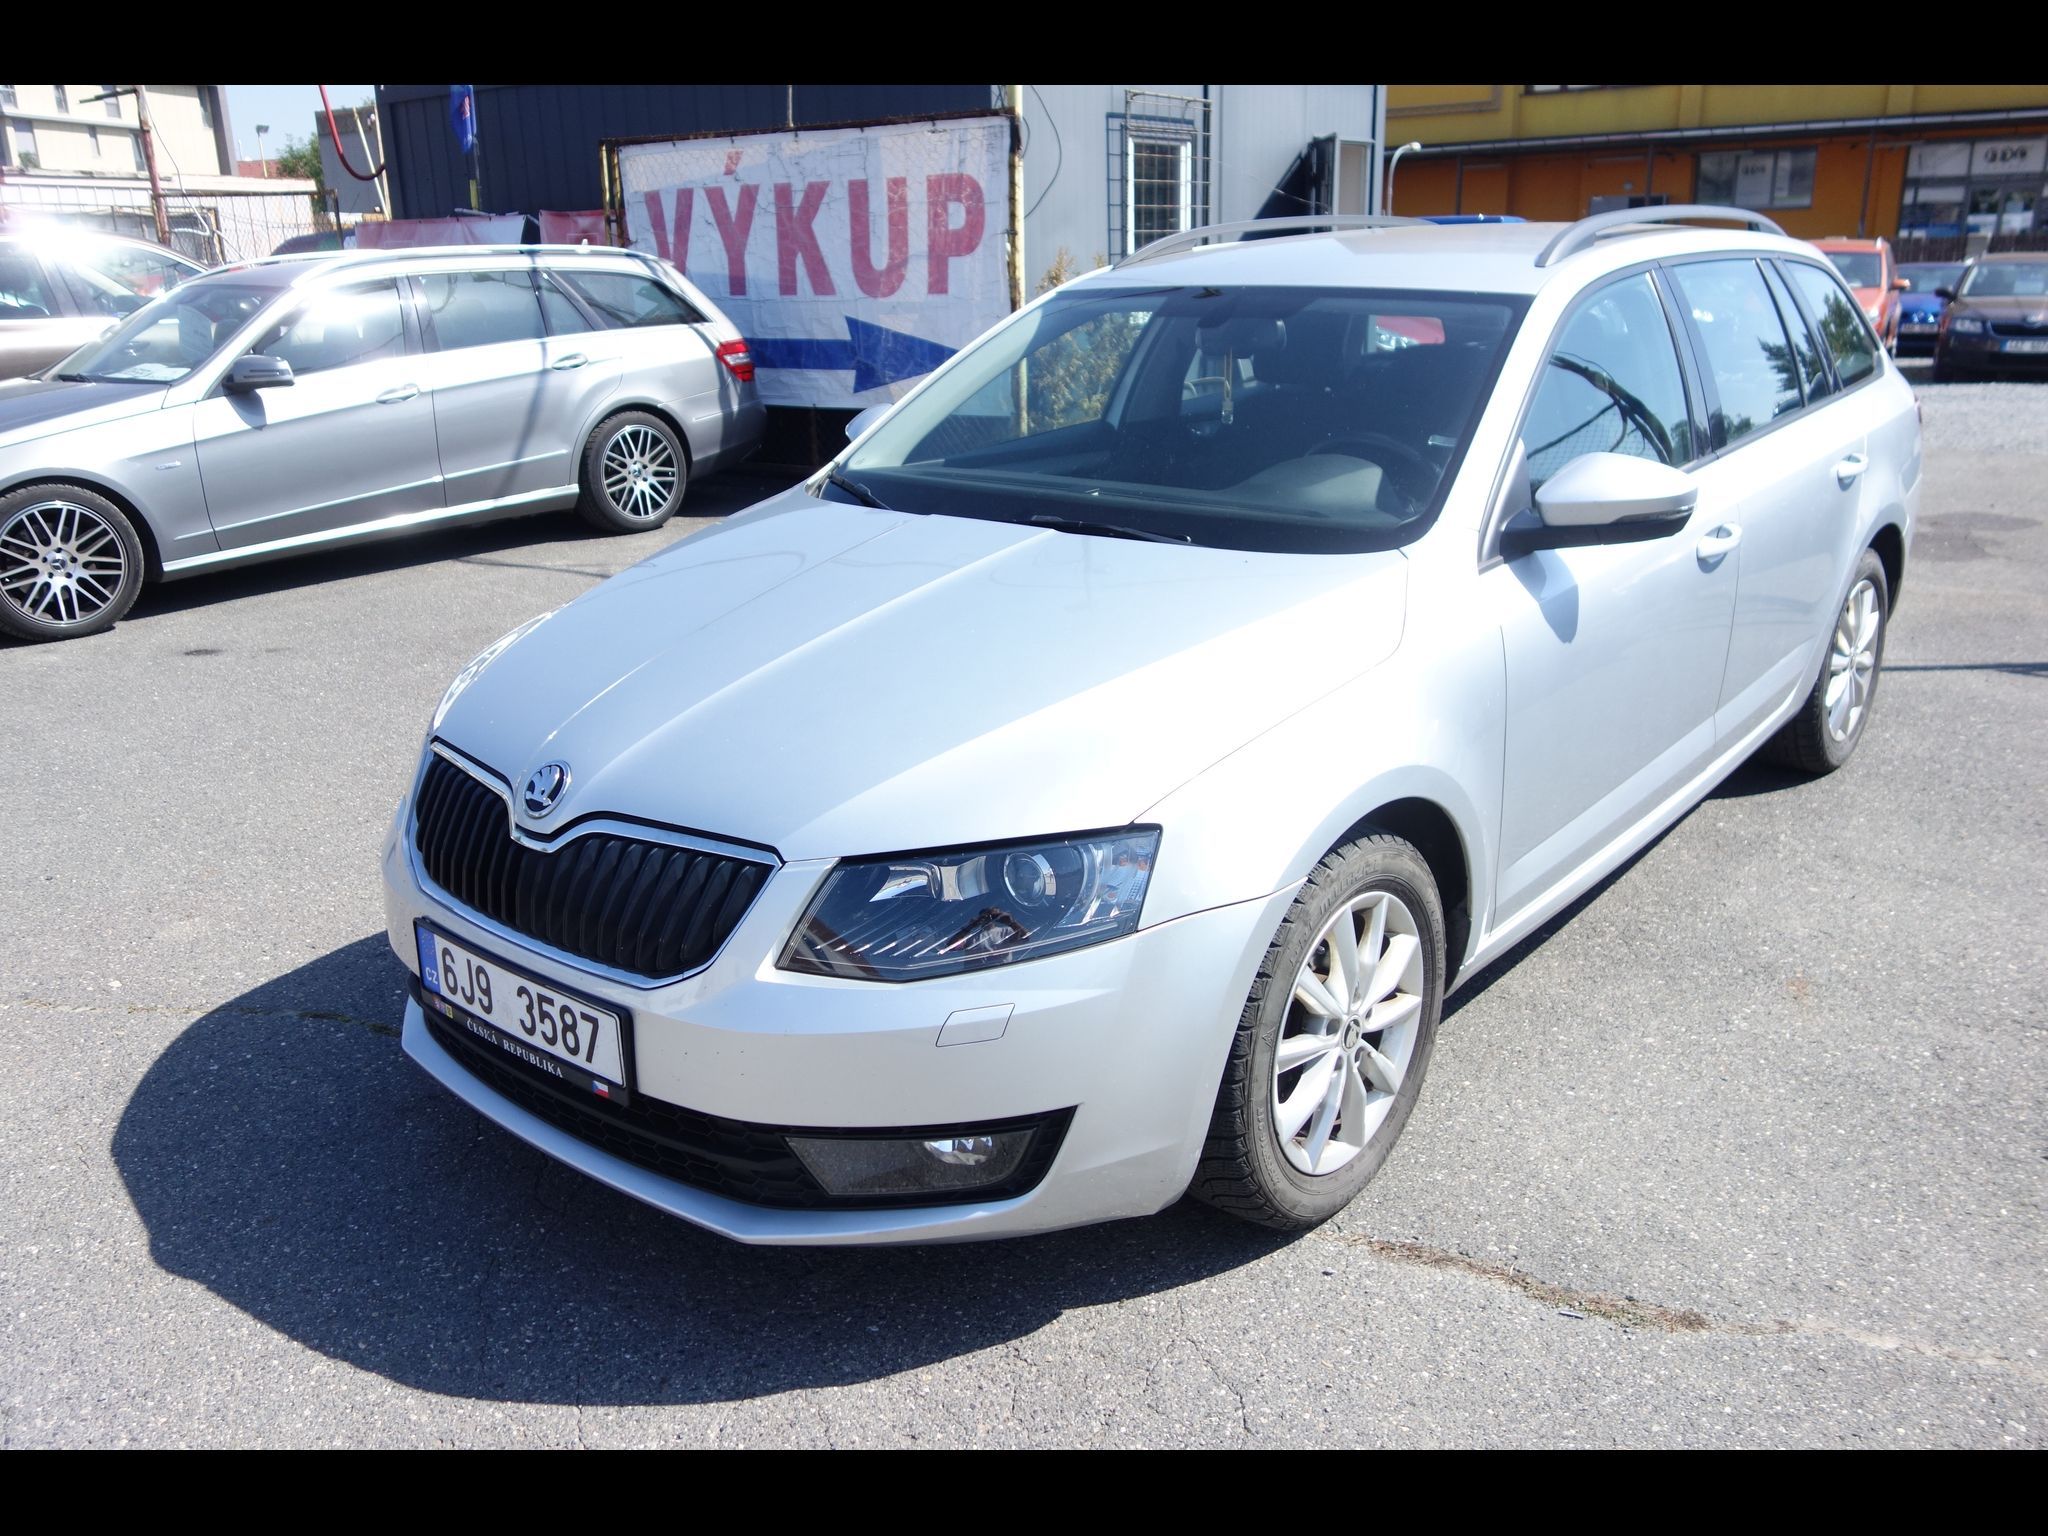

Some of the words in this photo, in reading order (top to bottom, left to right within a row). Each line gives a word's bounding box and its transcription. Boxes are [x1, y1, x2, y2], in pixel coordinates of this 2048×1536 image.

[644, 151, 985, 298] VÝKUP
[425, 966, 439, 985] CZ
[441, 946, 494, 1015] 6J9
[516, 985, 600, 1065] 3587
[466, 1017, 498, 1046] ČESKÁ
[503, 1039, 564, 1078] REPUBLIKA
